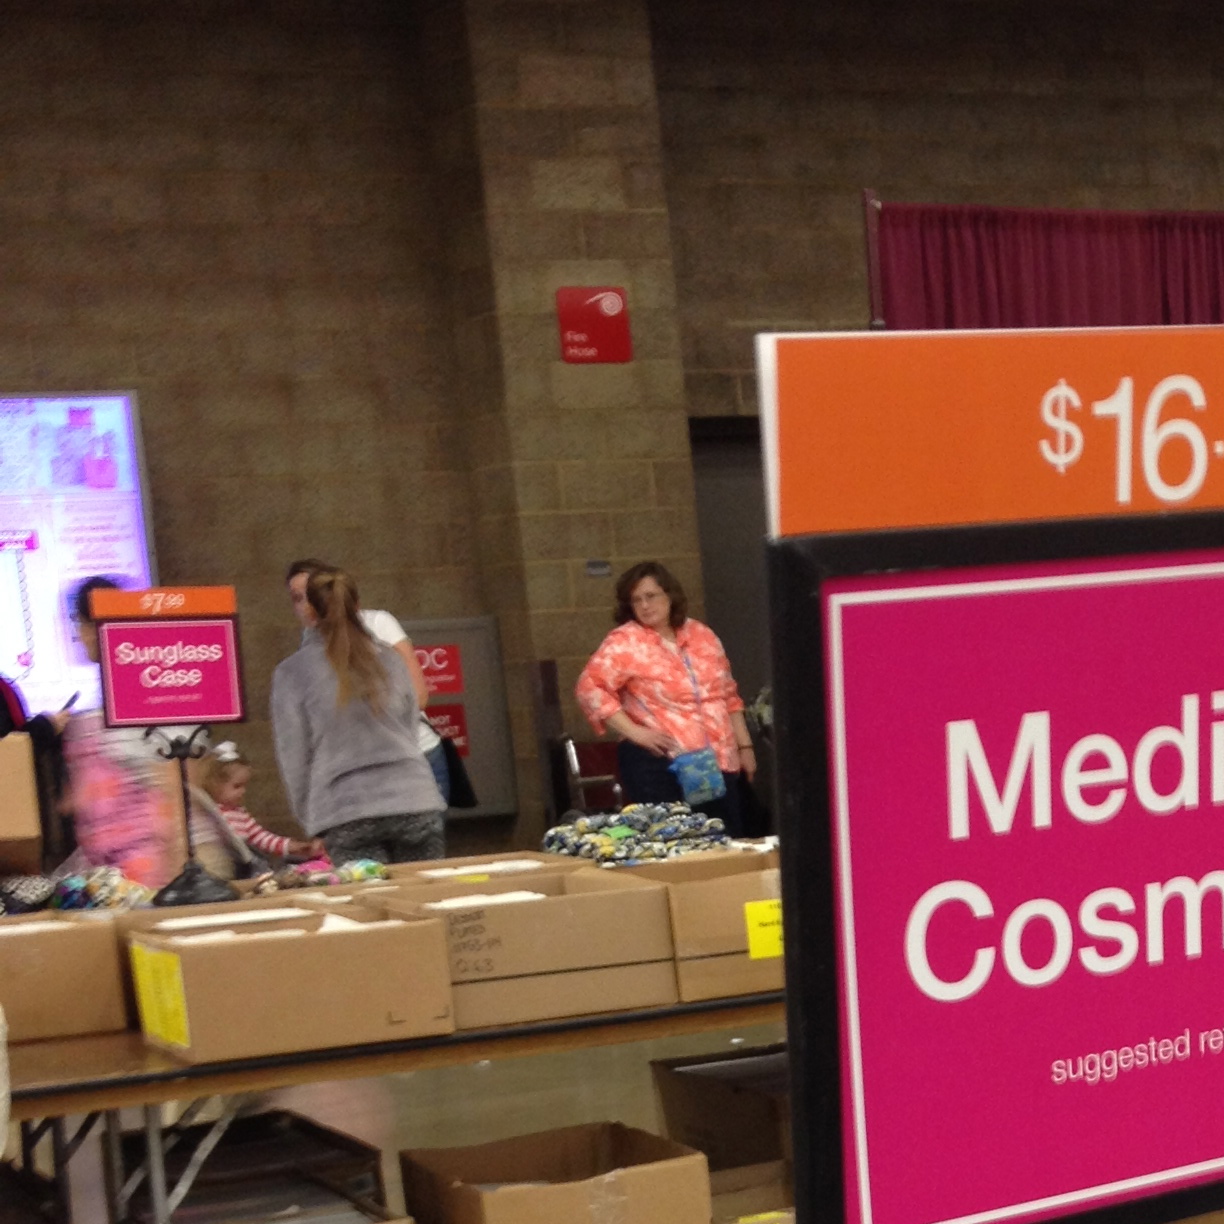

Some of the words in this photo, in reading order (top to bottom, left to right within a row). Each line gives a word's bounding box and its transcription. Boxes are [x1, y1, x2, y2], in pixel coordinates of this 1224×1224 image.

[114, 640, 224, 668] Sunglass
[138, 665, 203, 688] Case
[1050, 1029, 1191, 1084] suggested
